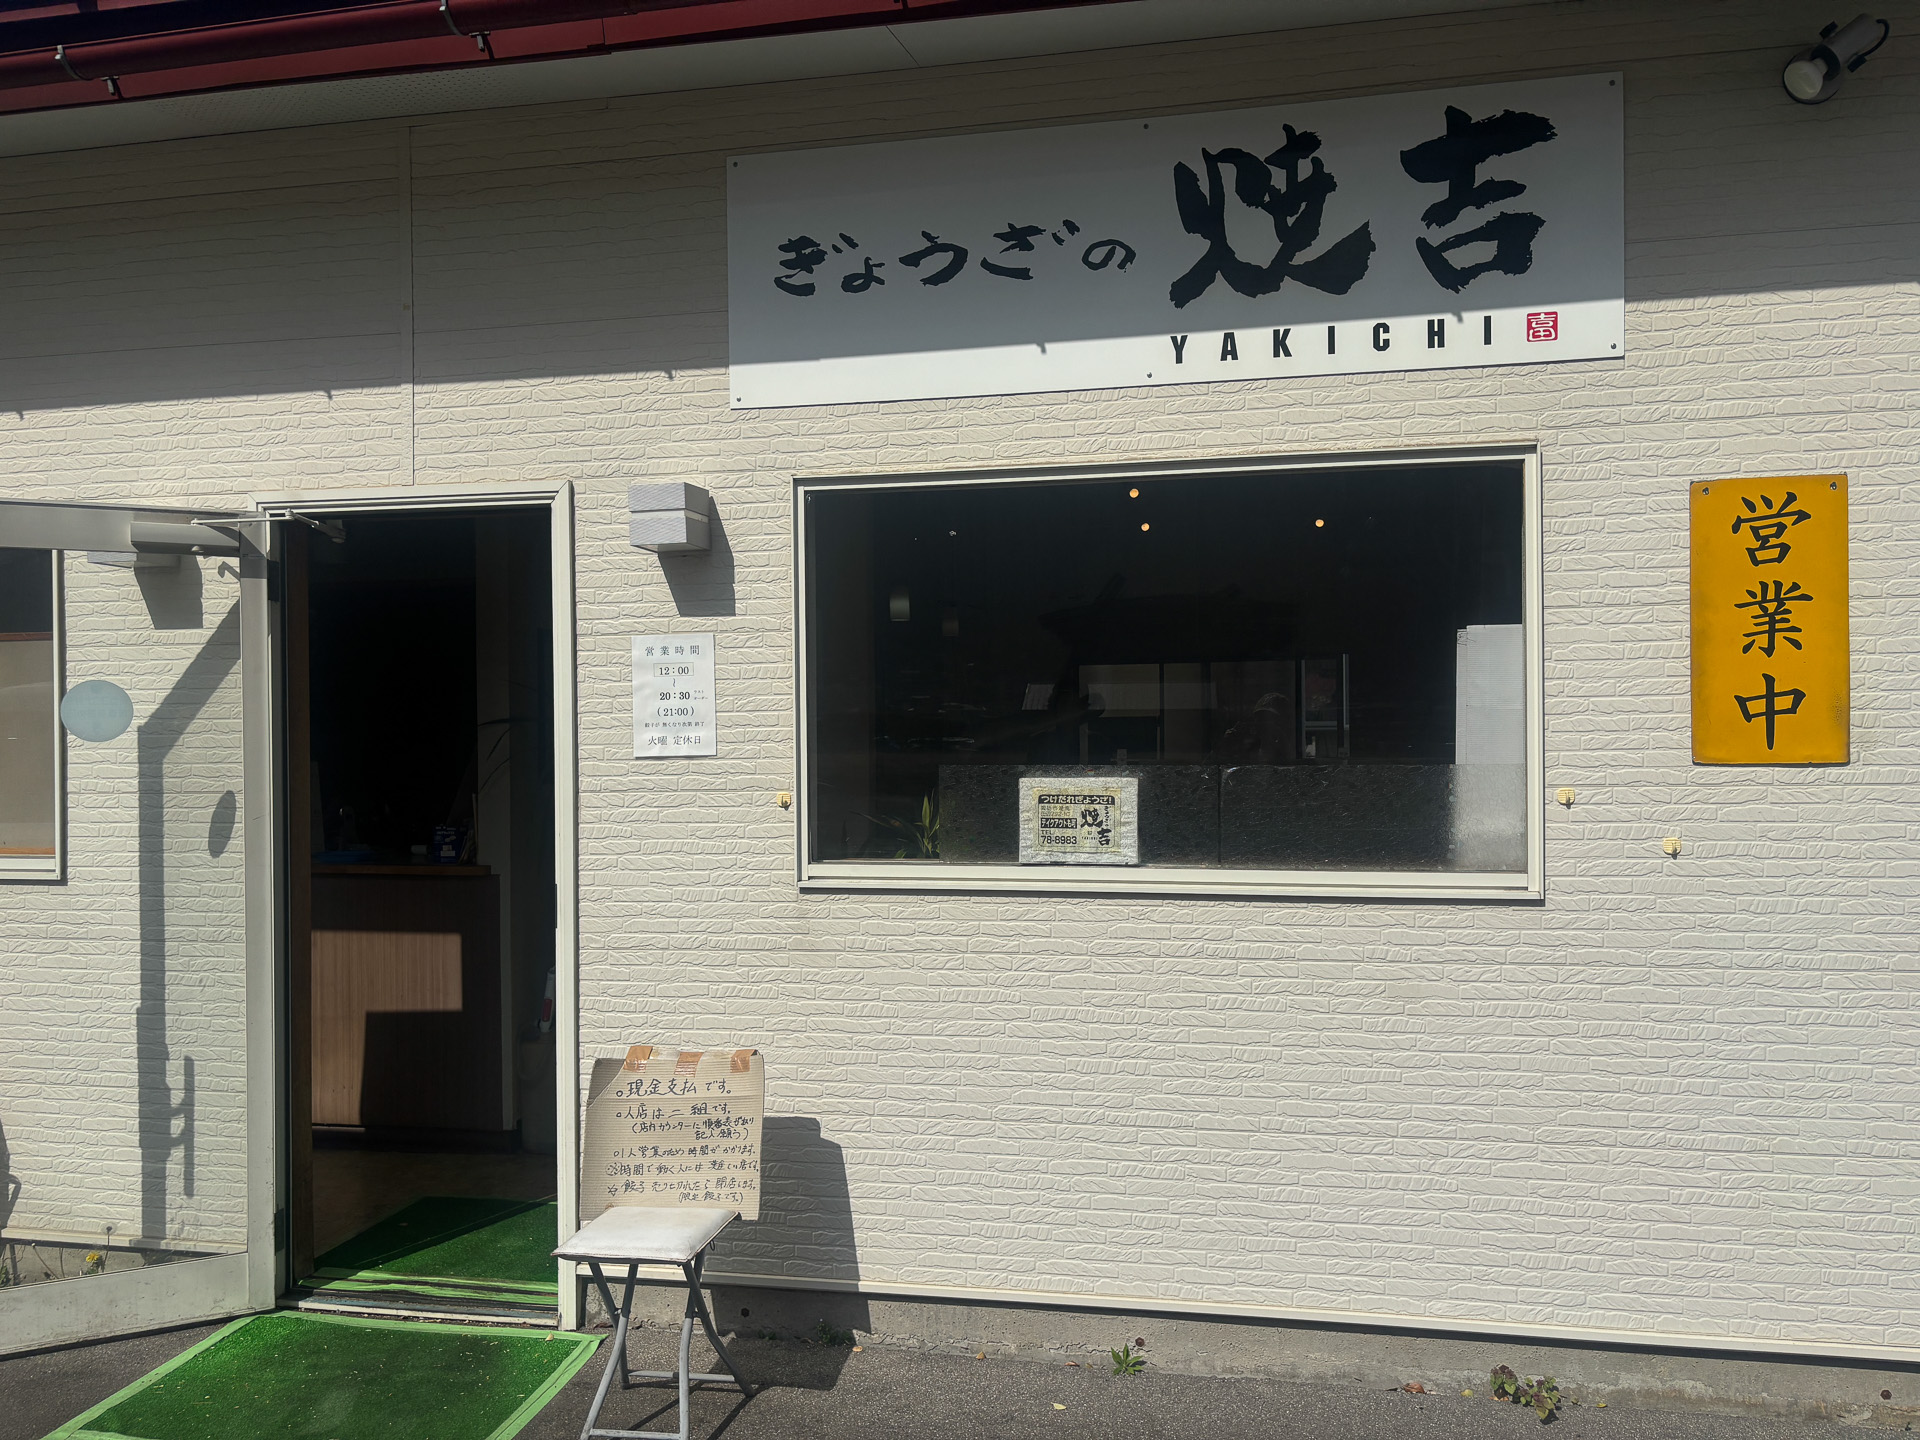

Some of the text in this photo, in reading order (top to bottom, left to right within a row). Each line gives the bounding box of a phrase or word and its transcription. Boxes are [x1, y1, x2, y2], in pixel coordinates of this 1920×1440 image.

[1170, 314, 1493, 365] YAKICHI
[1731, 491, 1814, 751] 営業中
[645, 645, 700, 657] 営業時間
[659, 666, 689, 675] 12:00
[659, 691, 691, 701] 20:30
[1041, 836, 1077, 844] 78-8983
